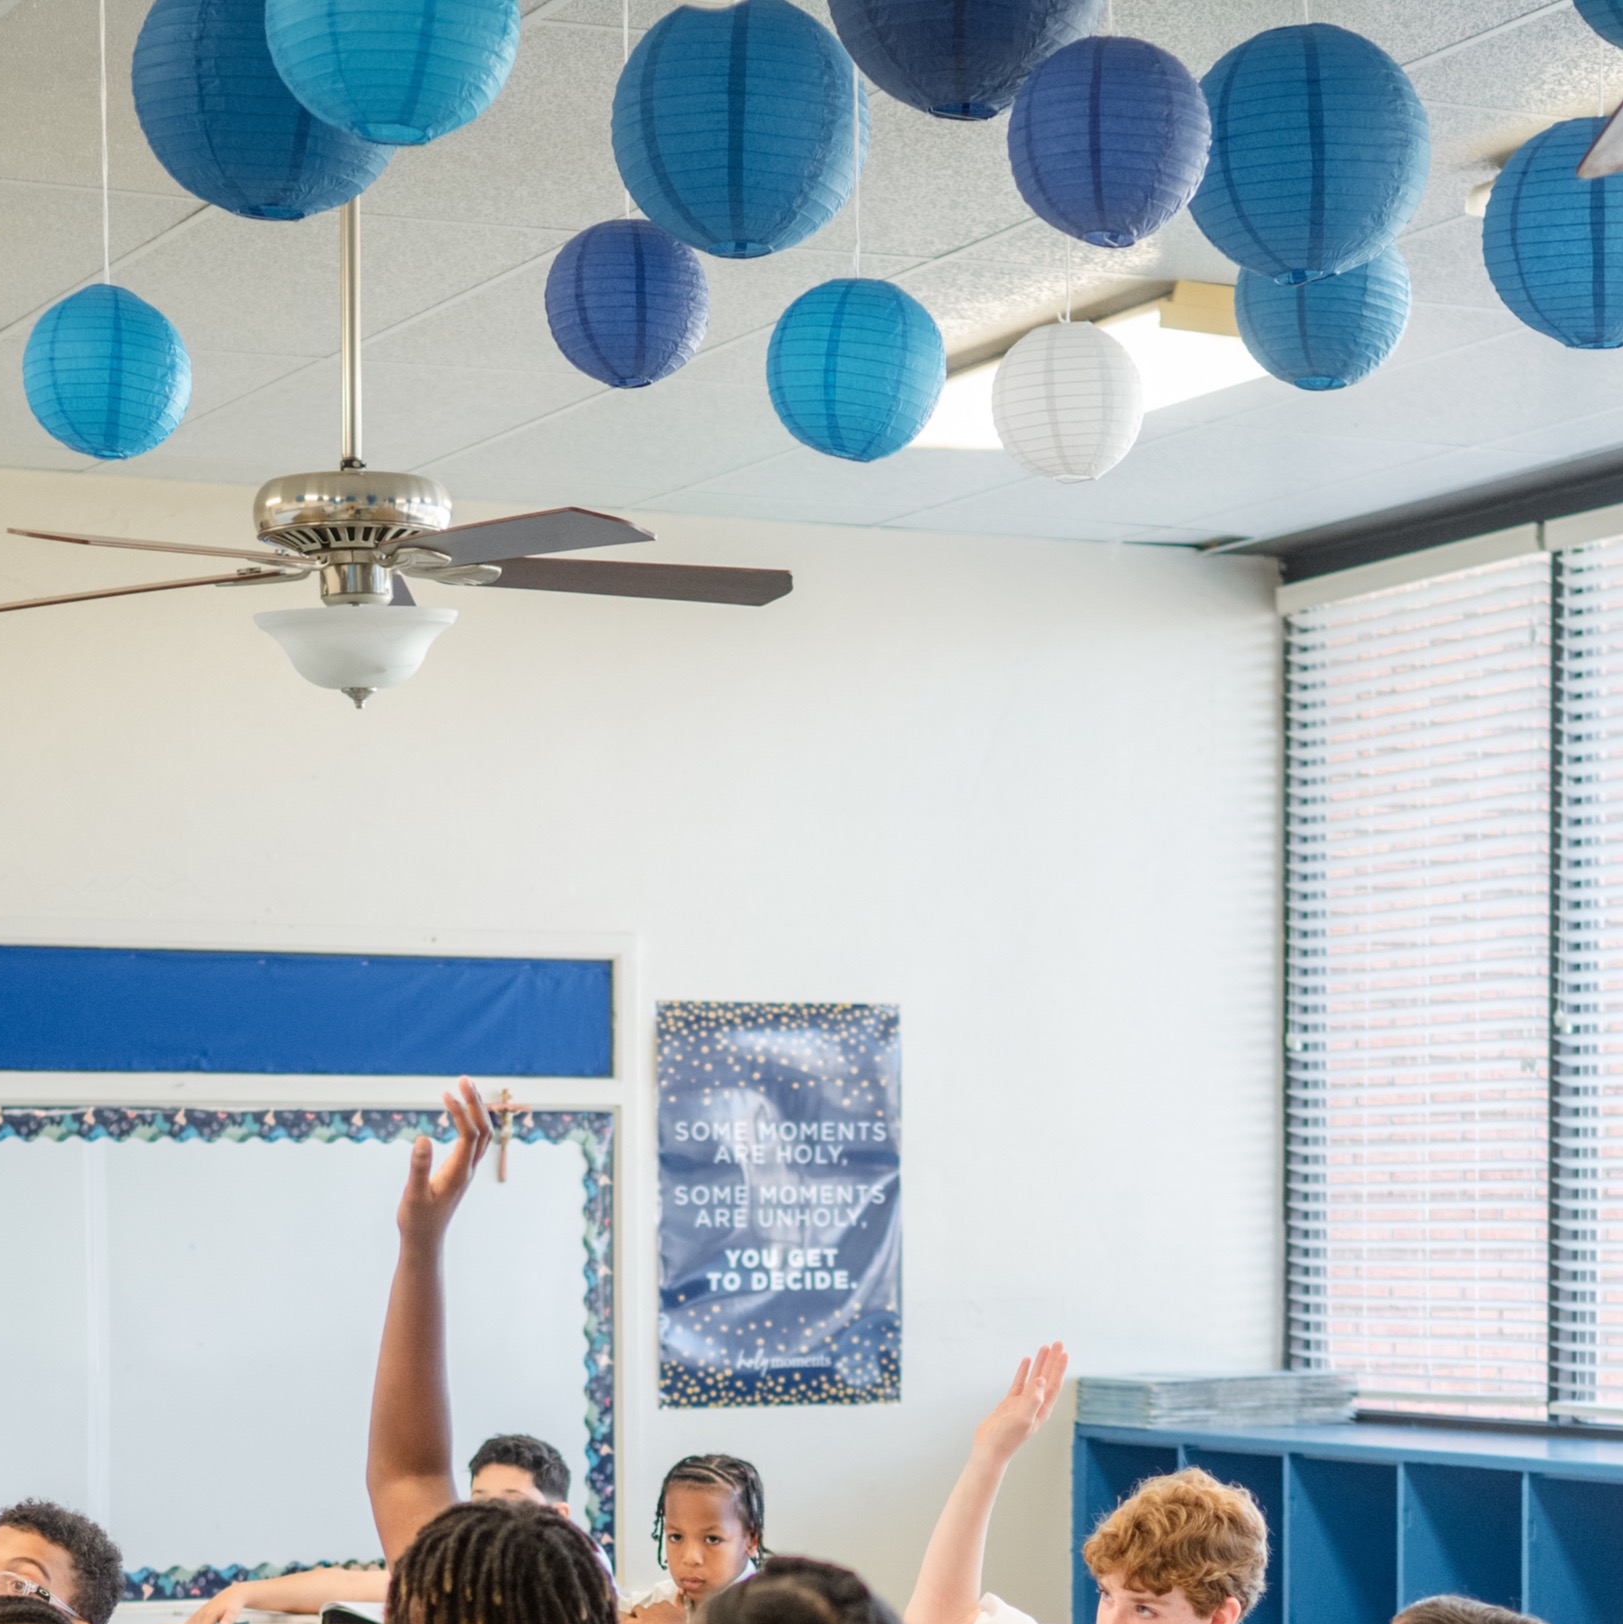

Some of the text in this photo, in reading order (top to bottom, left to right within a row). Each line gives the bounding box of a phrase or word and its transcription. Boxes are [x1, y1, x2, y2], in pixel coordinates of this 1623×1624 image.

[675, 1121, 887, 1142] SOME MOMENTS
[714, 1144, 849, 1166] ARE HOLY,
[674, 1185, 886, 1206] SOME MOMENTS
[694, 1208, 868, 1230] ARE UNHOLY,
[725, 1248, 839, 1268] YOU GET
[707, 1270, 858, 1291] TO DECIDE.
